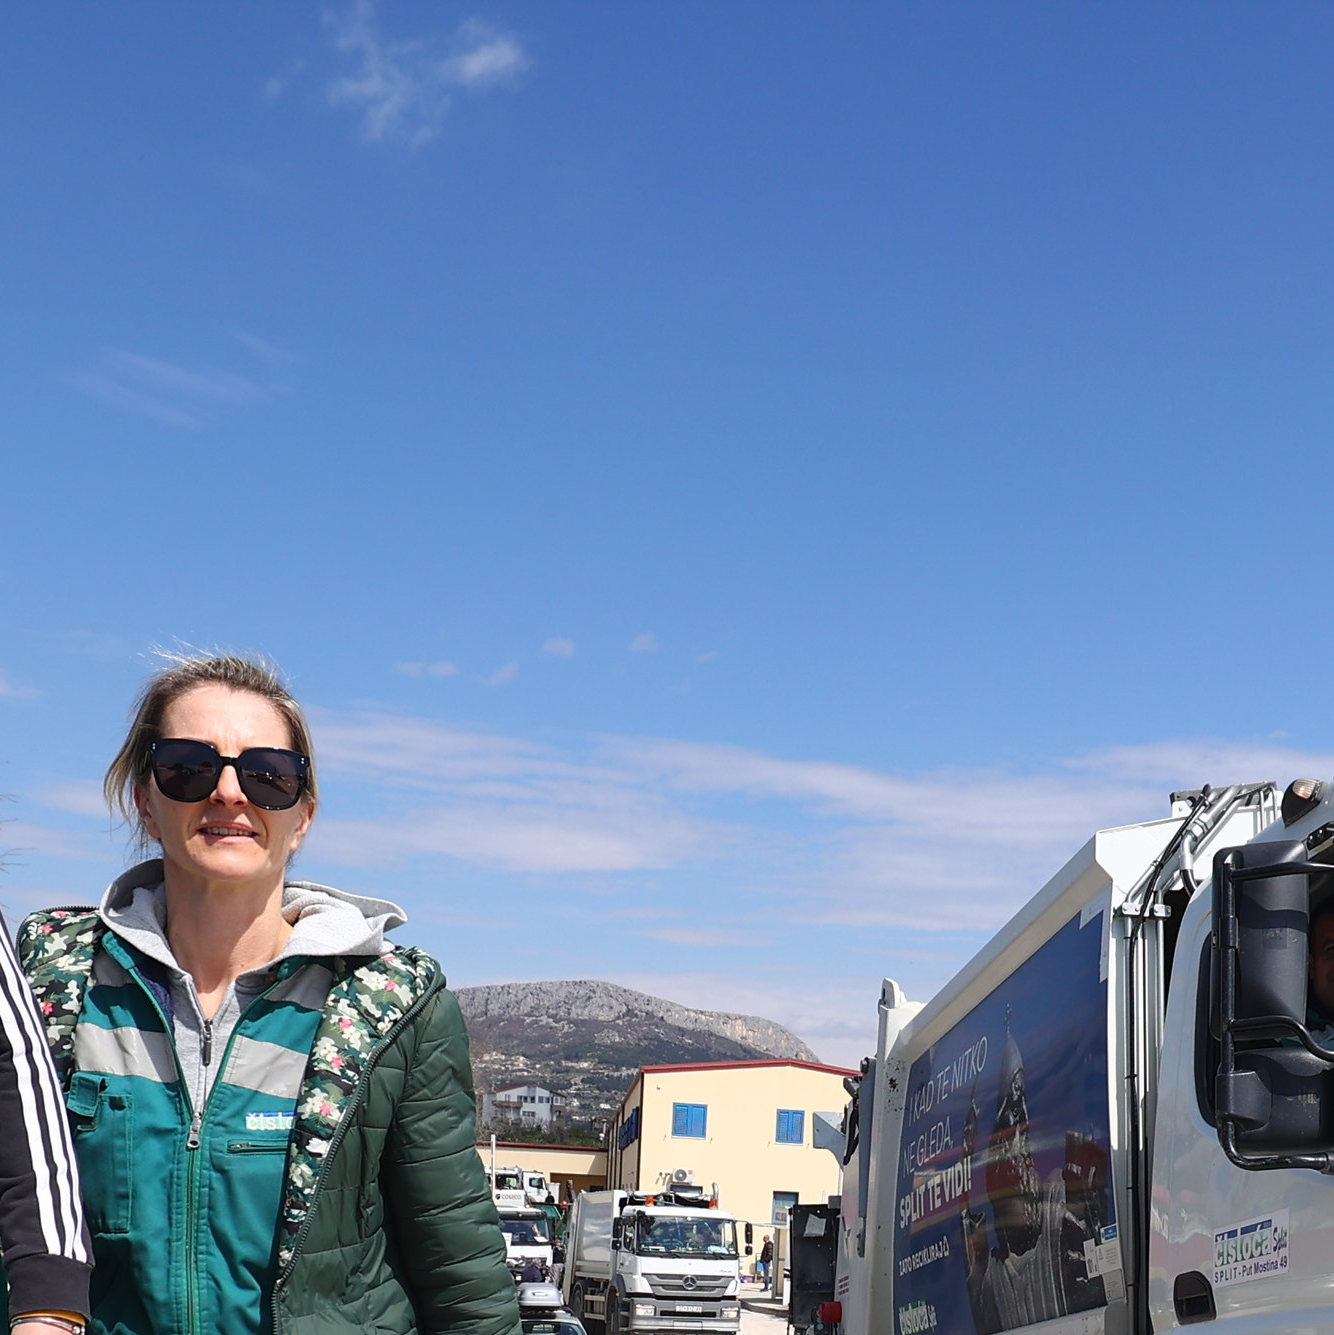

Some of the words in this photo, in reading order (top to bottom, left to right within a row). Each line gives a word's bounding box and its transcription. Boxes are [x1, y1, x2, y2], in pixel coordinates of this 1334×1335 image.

[913, 1080, 935, 1122] KAD
[937, 1065, 951, 1105] TE
[951, 1036, 987, 1093] NITKO
[902, 1141, 915, 1179] NE
[916, 1115, 953, 1167] GLEDA,
[900, 1184, 926, 1229] SPLIT
[927, 1174, 942, 1212] TE
[942, 1155, 972, 1203] VIDI!
[1253, 1259, 1278, 1275] Mostina
[1279, 1255, 1288, 1268] 49
[1272, 1226, 1288, 1258] Split
